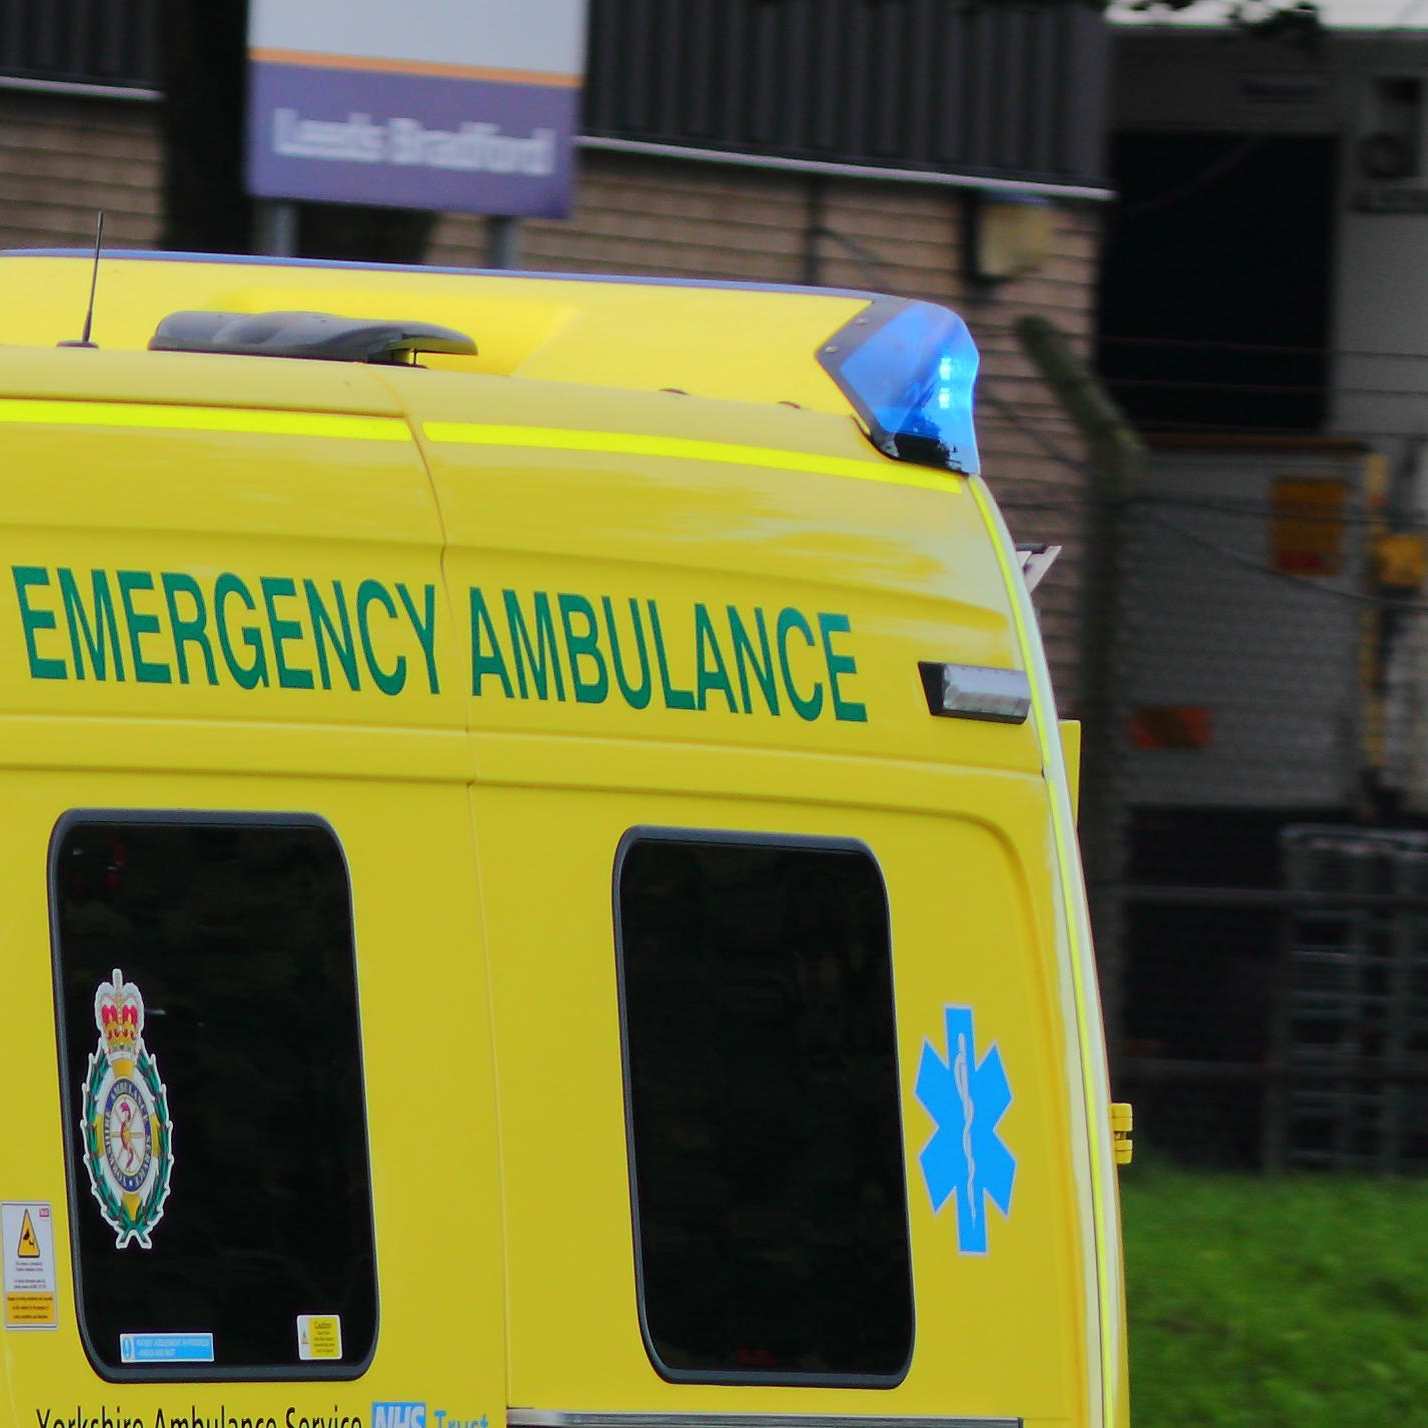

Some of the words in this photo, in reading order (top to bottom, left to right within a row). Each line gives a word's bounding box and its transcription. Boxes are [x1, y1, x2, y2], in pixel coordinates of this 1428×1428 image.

[274, 108, 385, 163] Leeds
[387, 117, 555, 176] Bradford
[11, 566, 441, 696] EMERGENCY
[470, 587, 868, 723] AMBULANCE
